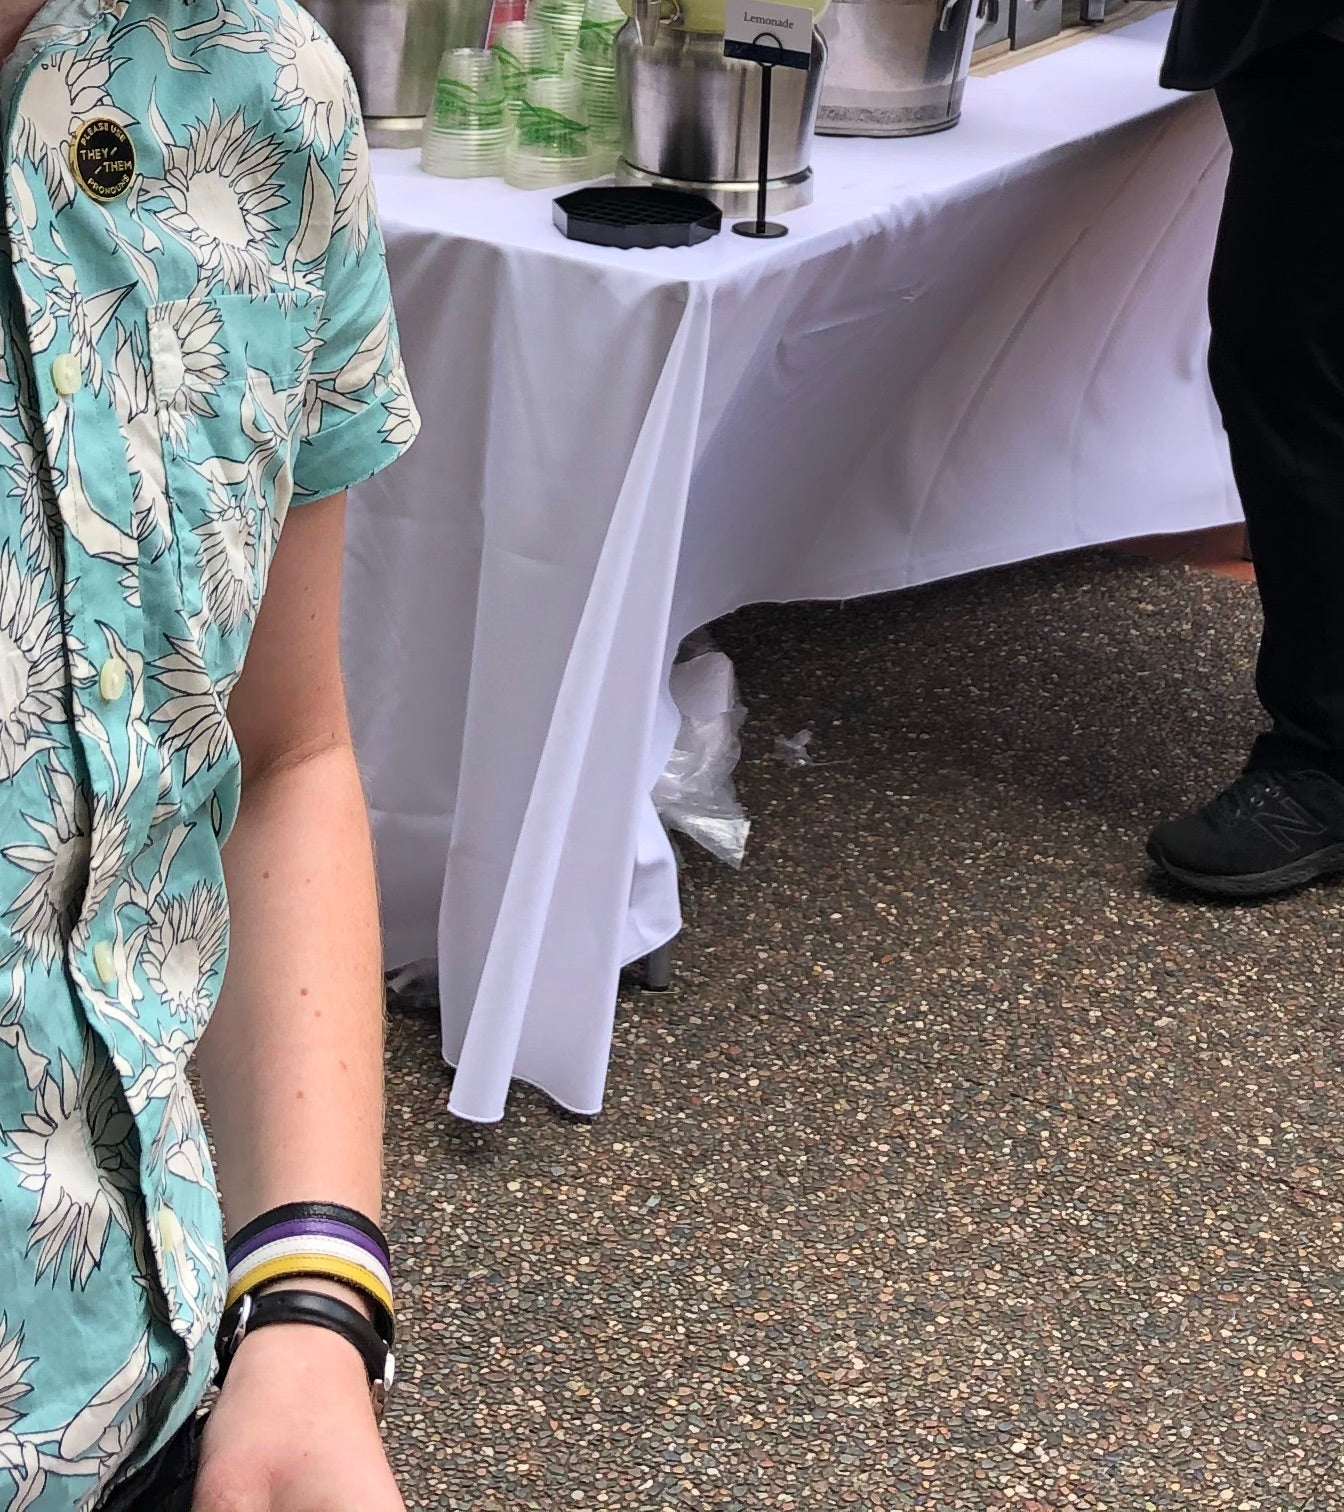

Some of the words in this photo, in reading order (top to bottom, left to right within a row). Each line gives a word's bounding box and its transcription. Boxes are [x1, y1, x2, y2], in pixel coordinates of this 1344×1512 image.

[744, 12, 794, 29] Lemonade
[81, 123, 109, 146] PLEASE
[110, 125, 126, 142] USE
[88, 174, 129, 194] PRONOUNS
